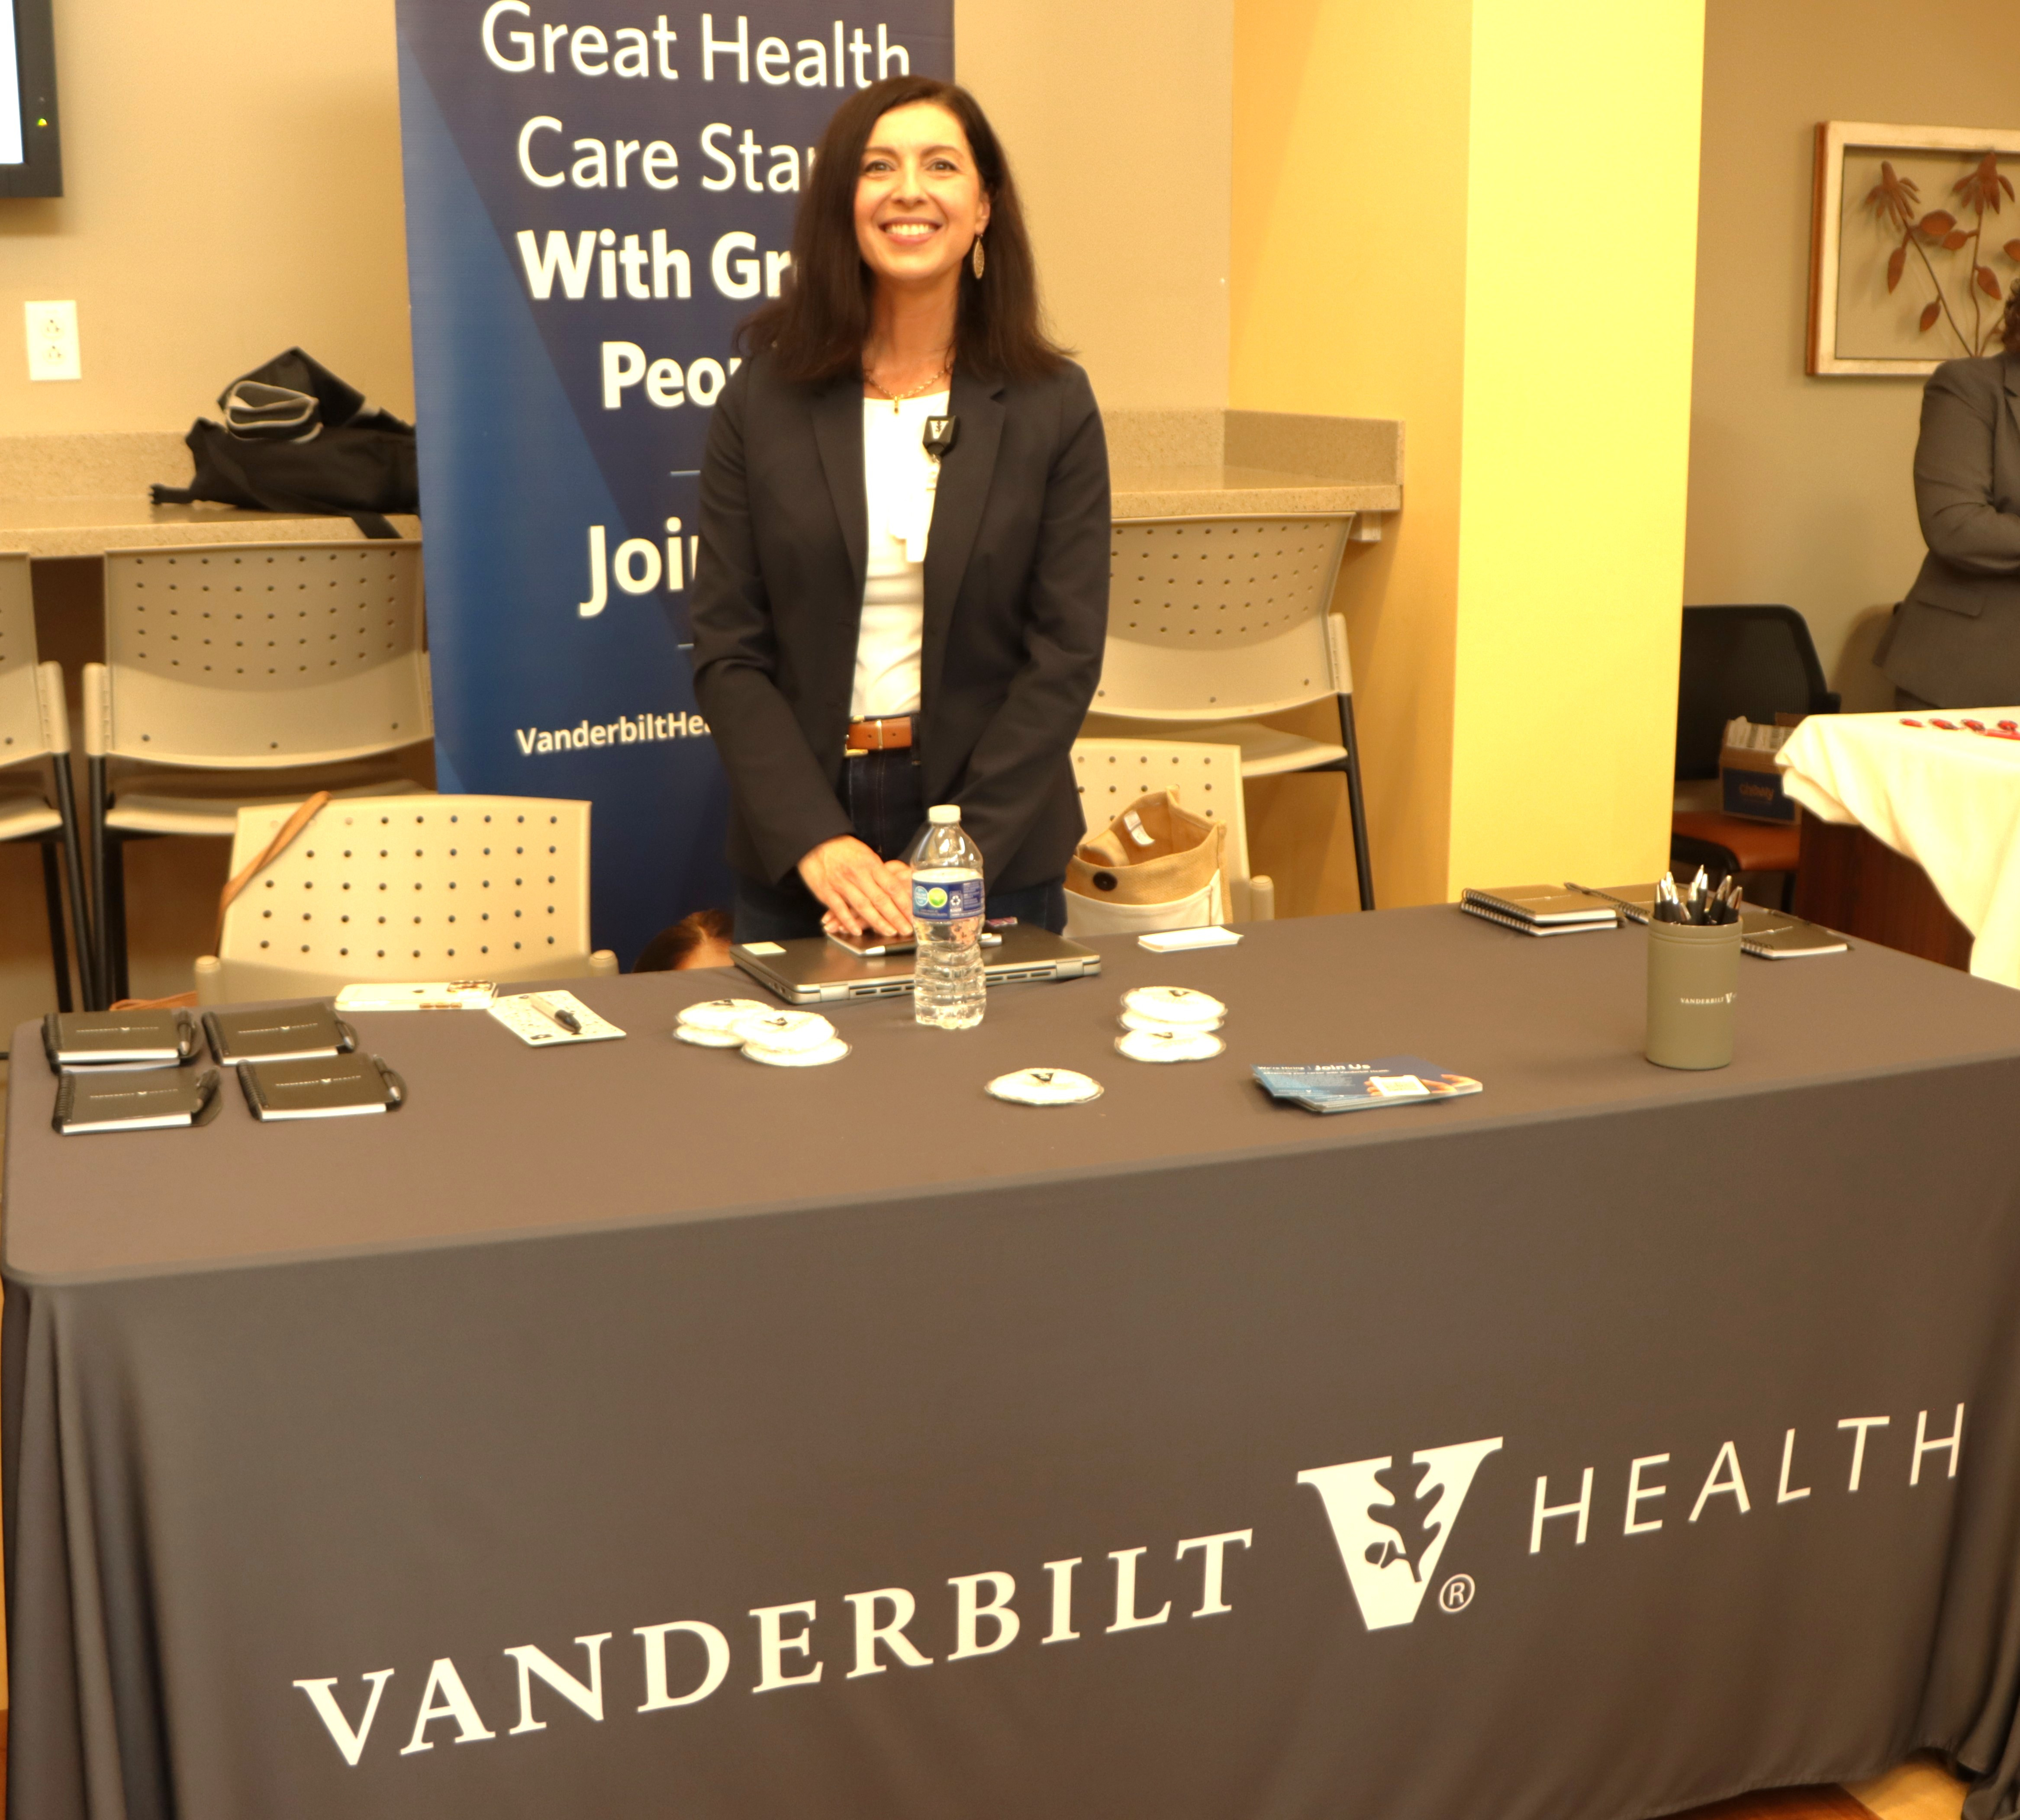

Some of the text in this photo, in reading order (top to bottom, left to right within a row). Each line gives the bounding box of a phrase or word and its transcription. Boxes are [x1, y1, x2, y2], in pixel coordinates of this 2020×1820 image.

[480, 0, 910, 89] Great Health
[517, 115, 679, 190] Care
[515, 228, 691, 300] With
[601, 341, 742, 409] Peo
[579, 517, 699, 618] Joi
[516, 711, 711, 755] VanderbiltHe
[293, 1528, 1253, 1766] VANDERBILT
[1530, 1403, 1964, 1554] HEALTH
